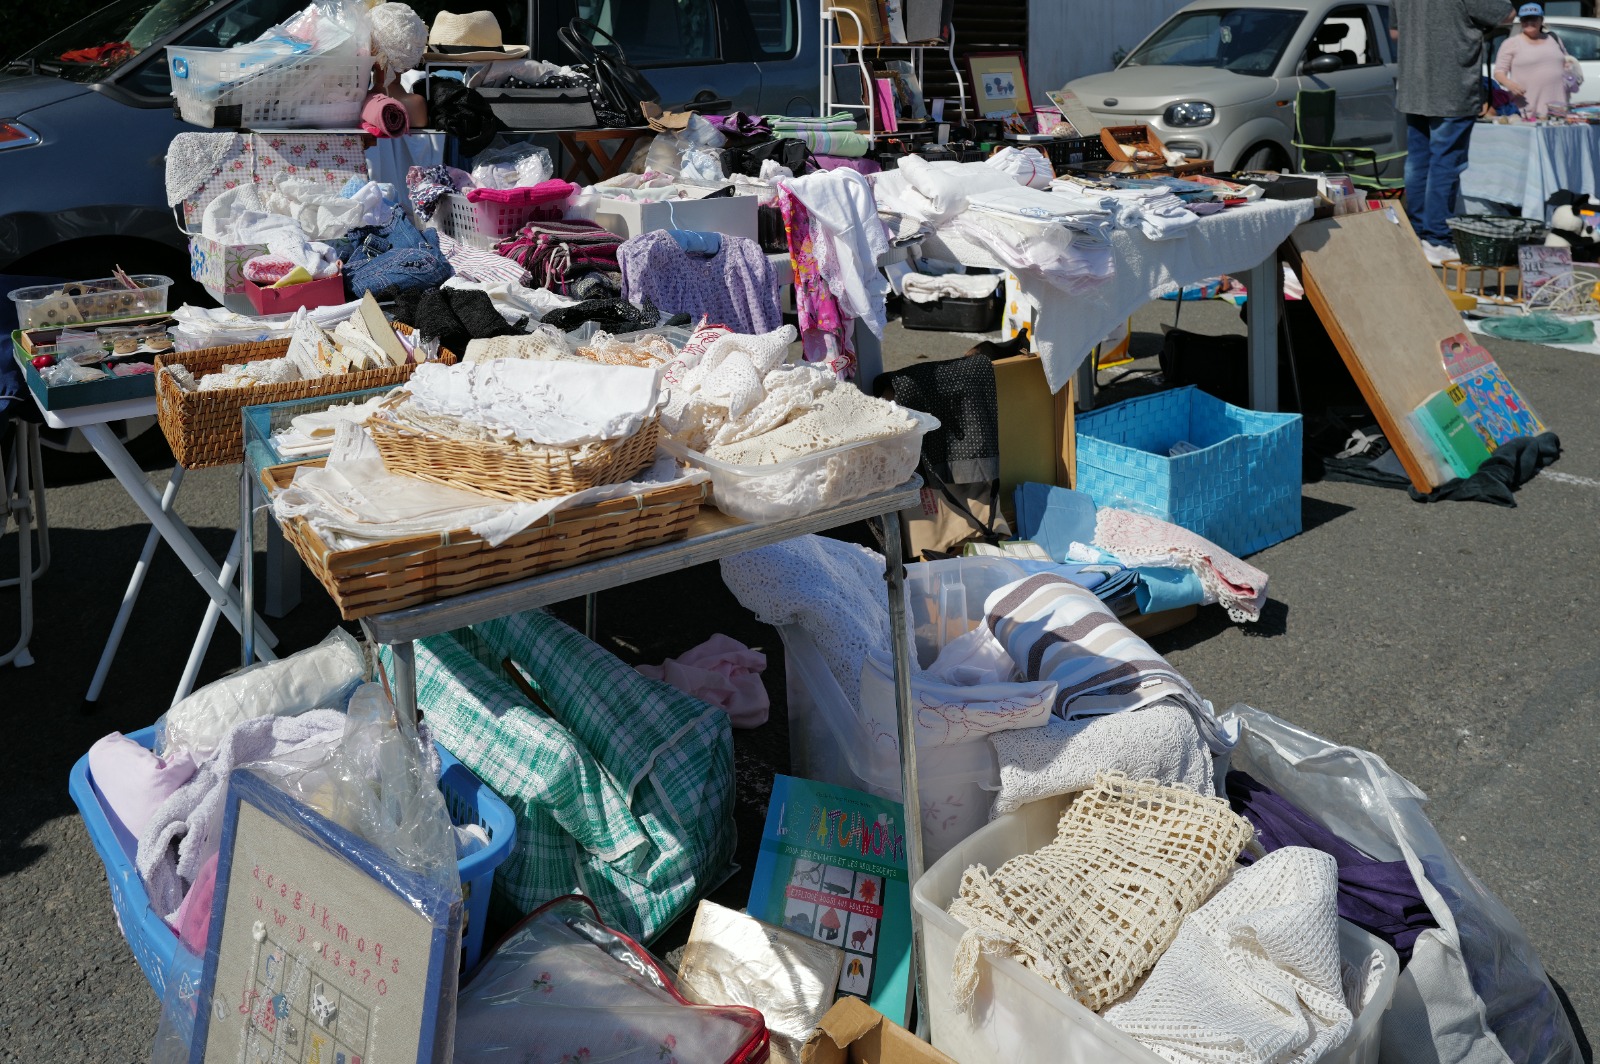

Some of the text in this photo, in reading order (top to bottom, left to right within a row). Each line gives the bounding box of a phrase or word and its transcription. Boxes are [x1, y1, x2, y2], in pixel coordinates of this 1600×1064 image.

[806, 804, 904, 864] PATCHWORK
[813, 852, 837, 864] ENFANTS
[837, 857, 846, 867] ET
[848, 859, 858, 869] LES
[860, 863, 897, 877] ADOLESCENTS
[820, 894, 836, 906] AUSSI
[838, 898, 848, 908] AUX
